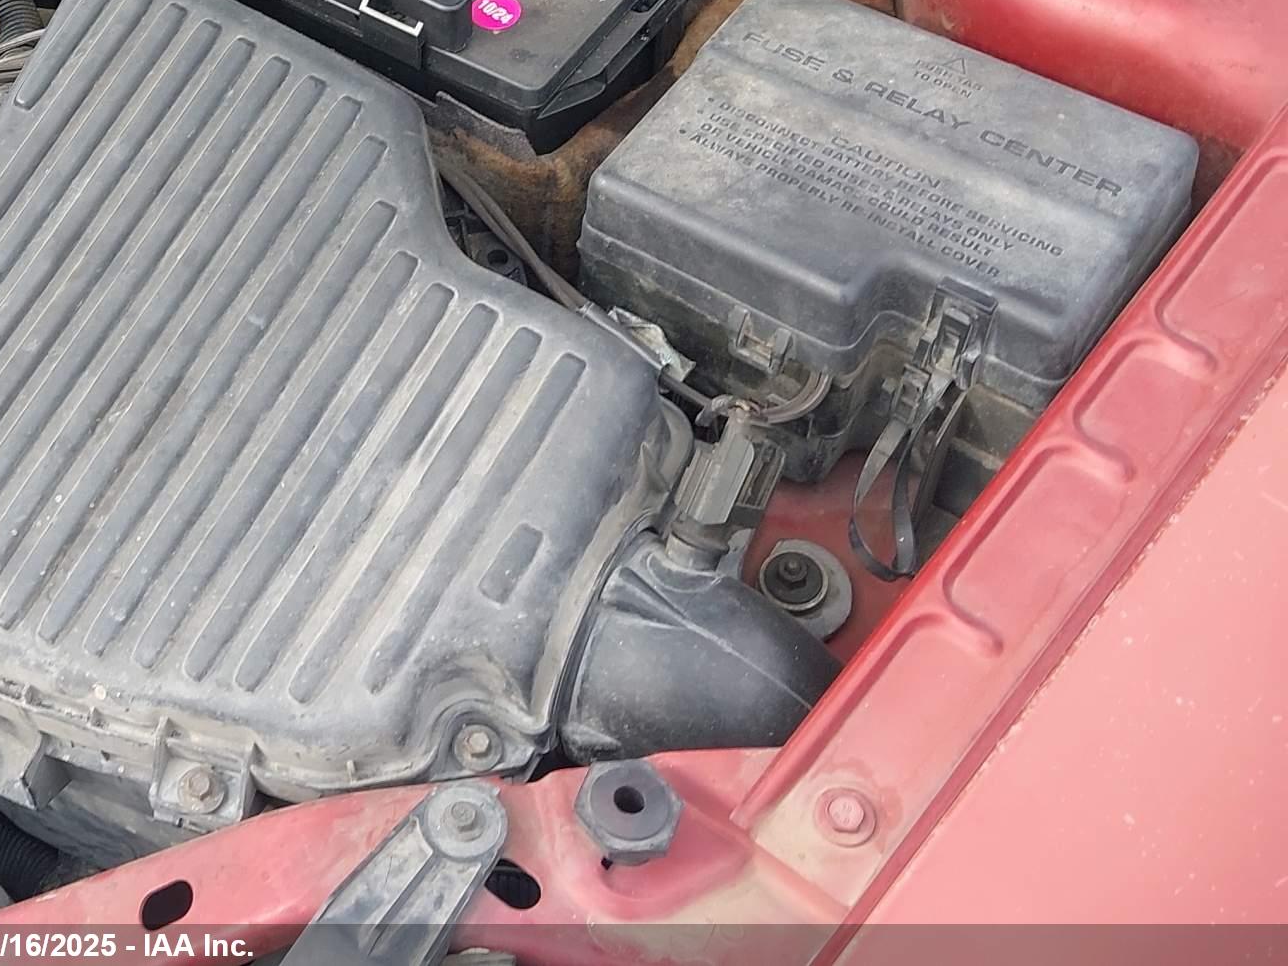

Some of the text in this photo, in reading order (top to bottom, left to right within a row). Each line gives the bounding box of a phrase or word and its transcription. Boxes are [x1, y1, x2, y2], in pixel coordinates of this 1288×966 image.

[477, 0, 514, 24] 10/24
[742, 32, 1125, 197] FUSE & RELAY CENTER
[912, 71, 972, 97] TO OPEN
[690, 133, 755, 165] ALWAYS
[756, 163, 838, 201] PROPERLY
[940, 246, 1002, 276] COVER
[700, 122, 726, 137] OR
[725, 135, 795, 167] VEHICLE
[927, 224, 994, 256] RESULT
[709, 111, 745, 131] USE
[743, 128, 826, 166] SPECIFIED
[826, 164, 886, 193] FUSES
[966, 226, 1015, 251] ONLY
[821, 147, 896, 181] BATTERY
[897, 180, 966, 212] BEFORE
[966, 210, 1065, 255] SERVICING
[828, 136, 943, 187] CAUTION
